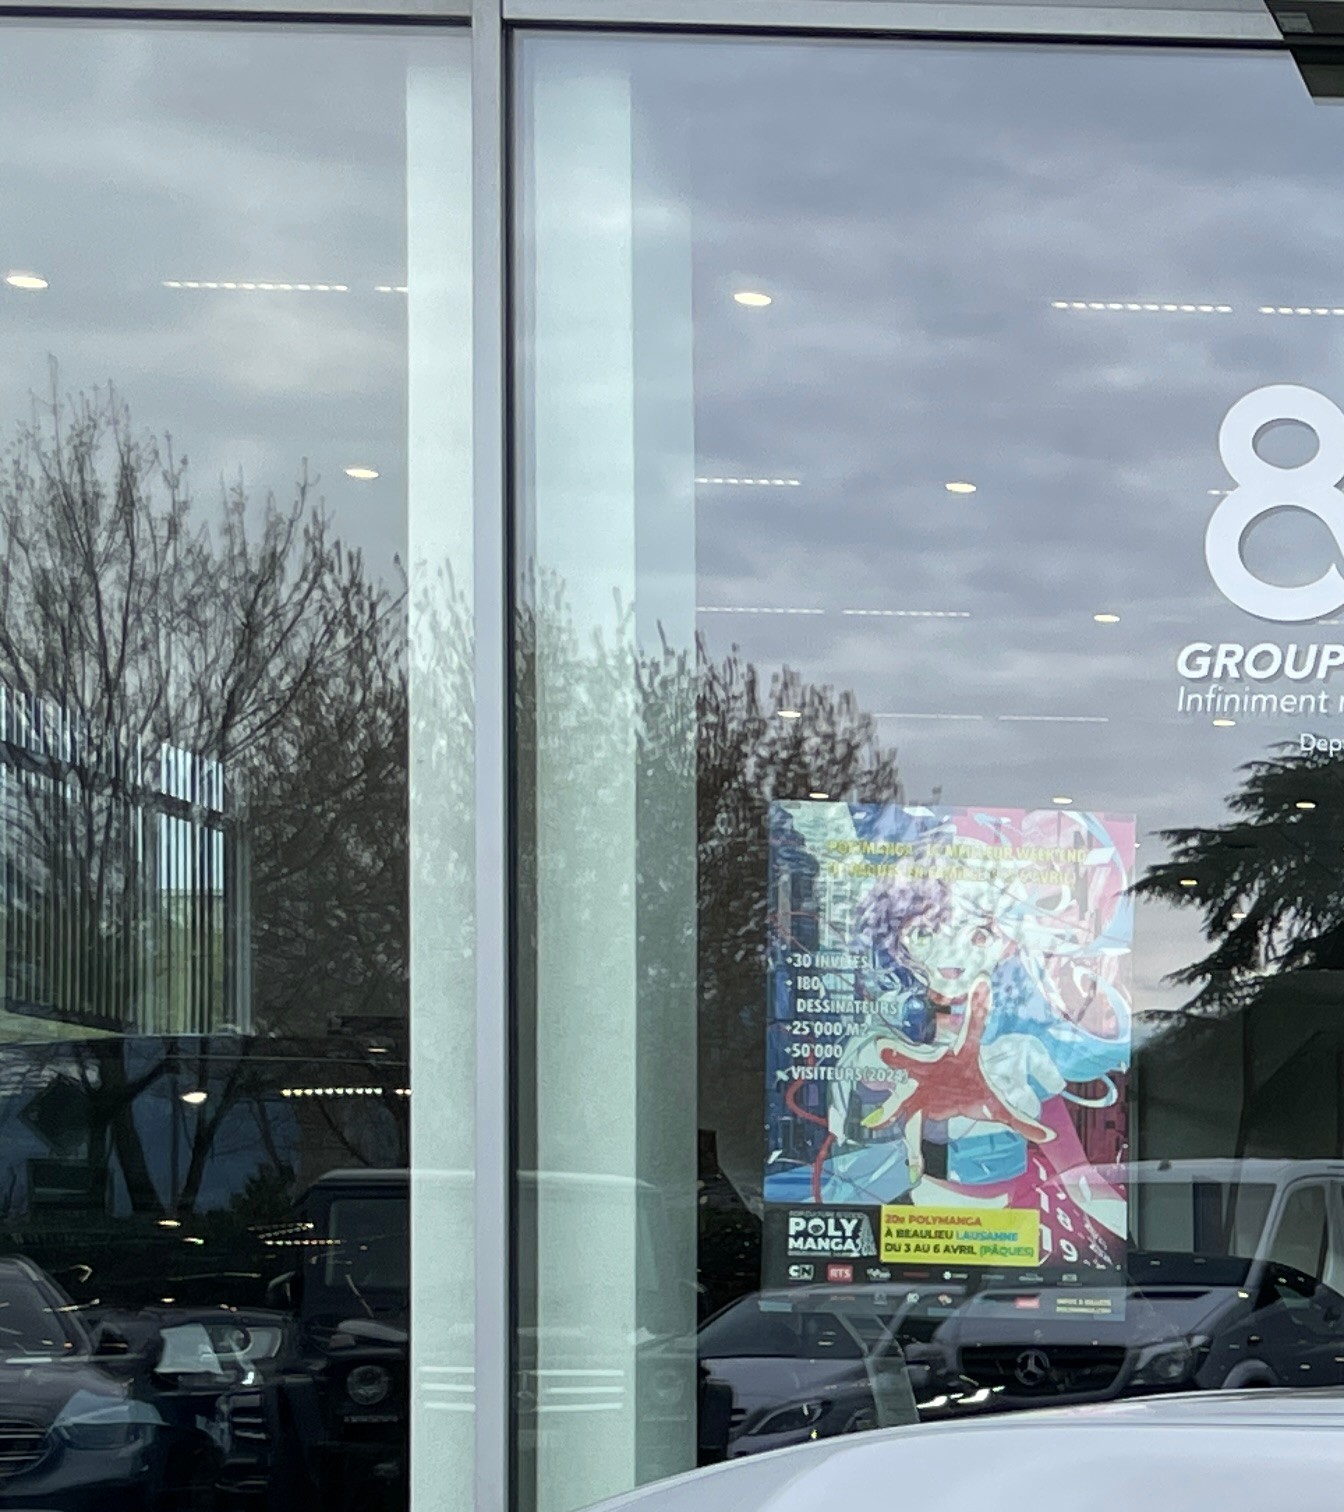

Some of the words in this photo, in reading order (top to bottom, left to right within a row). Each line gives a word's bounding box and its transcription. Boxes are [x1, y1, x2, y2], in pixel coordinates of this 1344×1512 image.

[1178, 685, 1330, 717] Infiniment
[796, 998, 898, 1014] DESSINATEURS
[789, 1217, 859, 1236] POLY
[896, 1228, 954, 1240] BEAULIEU
[788, 1236, 856, 1251] MANGA
[884, 1242, 901, 1253] DU
[913, 1243, 931, 1254] AU
[943, 1244, 977, 1255] AVRIL
